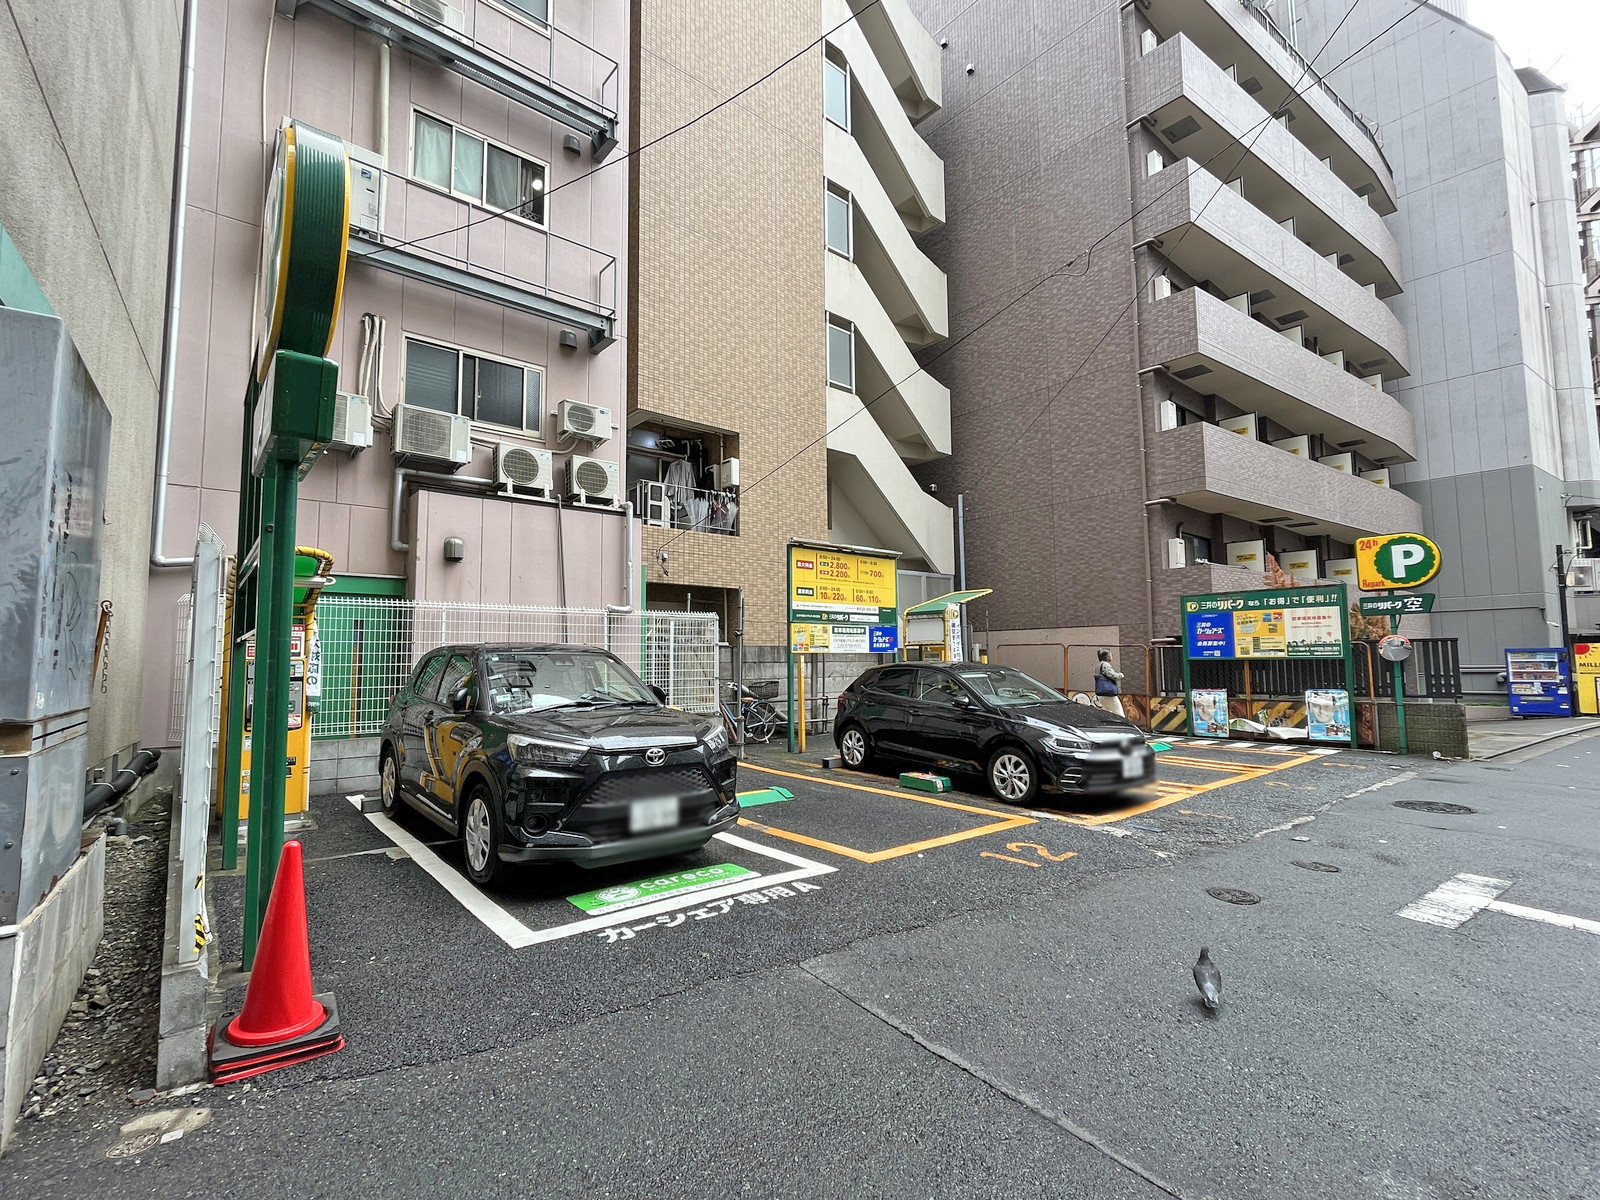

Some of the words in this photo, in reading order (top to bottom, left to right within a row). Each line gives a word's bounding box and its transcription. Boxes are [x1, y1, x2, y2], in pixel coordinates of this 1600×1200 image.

[1359, 540, 1378, 551] 24h
[1391, 544, 1425, 578] P
[1362, 579, 1386, 588] Repark
[1201, 599, 1244, 610] 三井のリパーク
[1362, 601, 1403, 610] 三井のリパーク
[1404, 596, 1423, 611] 空
[640, 866, 724, 889] careco
